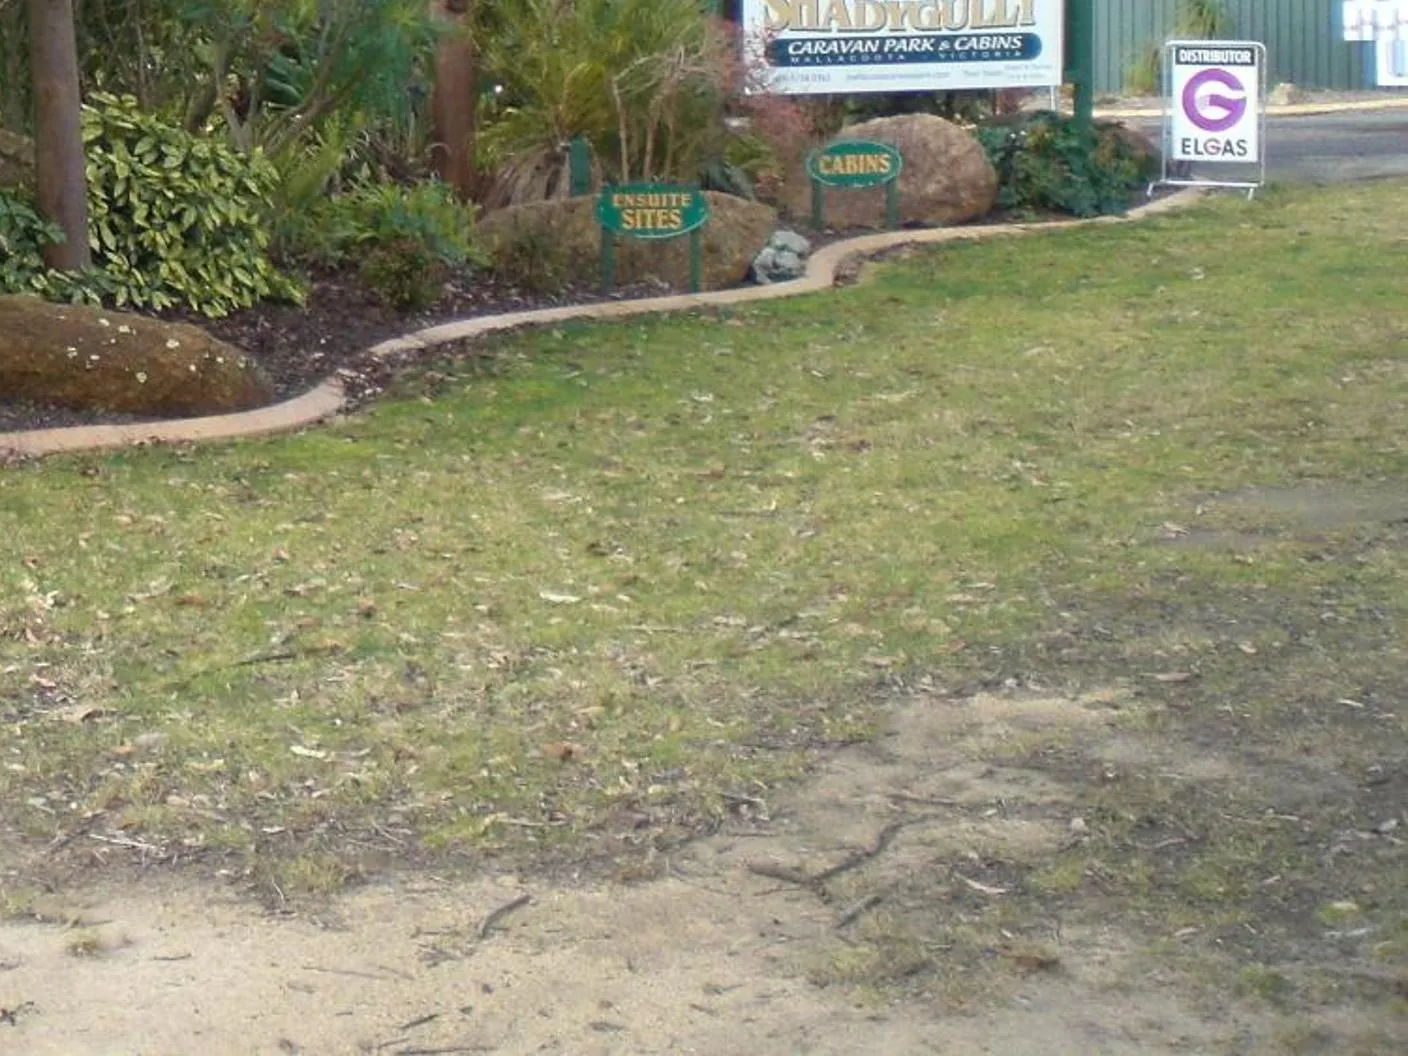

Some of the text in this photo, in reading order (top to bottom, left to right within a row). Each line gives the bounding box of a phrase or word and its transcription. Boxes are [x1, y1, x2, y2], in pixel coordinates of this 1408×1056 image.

[787, 39, 879, 54] CARAVAN
[884, 37, 935, 52] PARK
[954, 35, 1023, 50] CABINS
[791, 54, 905, 64] MALLACOOTA
[1179, 50, 1252, 63] DISTRIBUTOR
[1181, 138, 1248, 157] ELGAS
[818, 153, 891, 177] CABINS
[613, 193, 692, 207] ENSUITE
[622, 209, 682, 230] SITES
